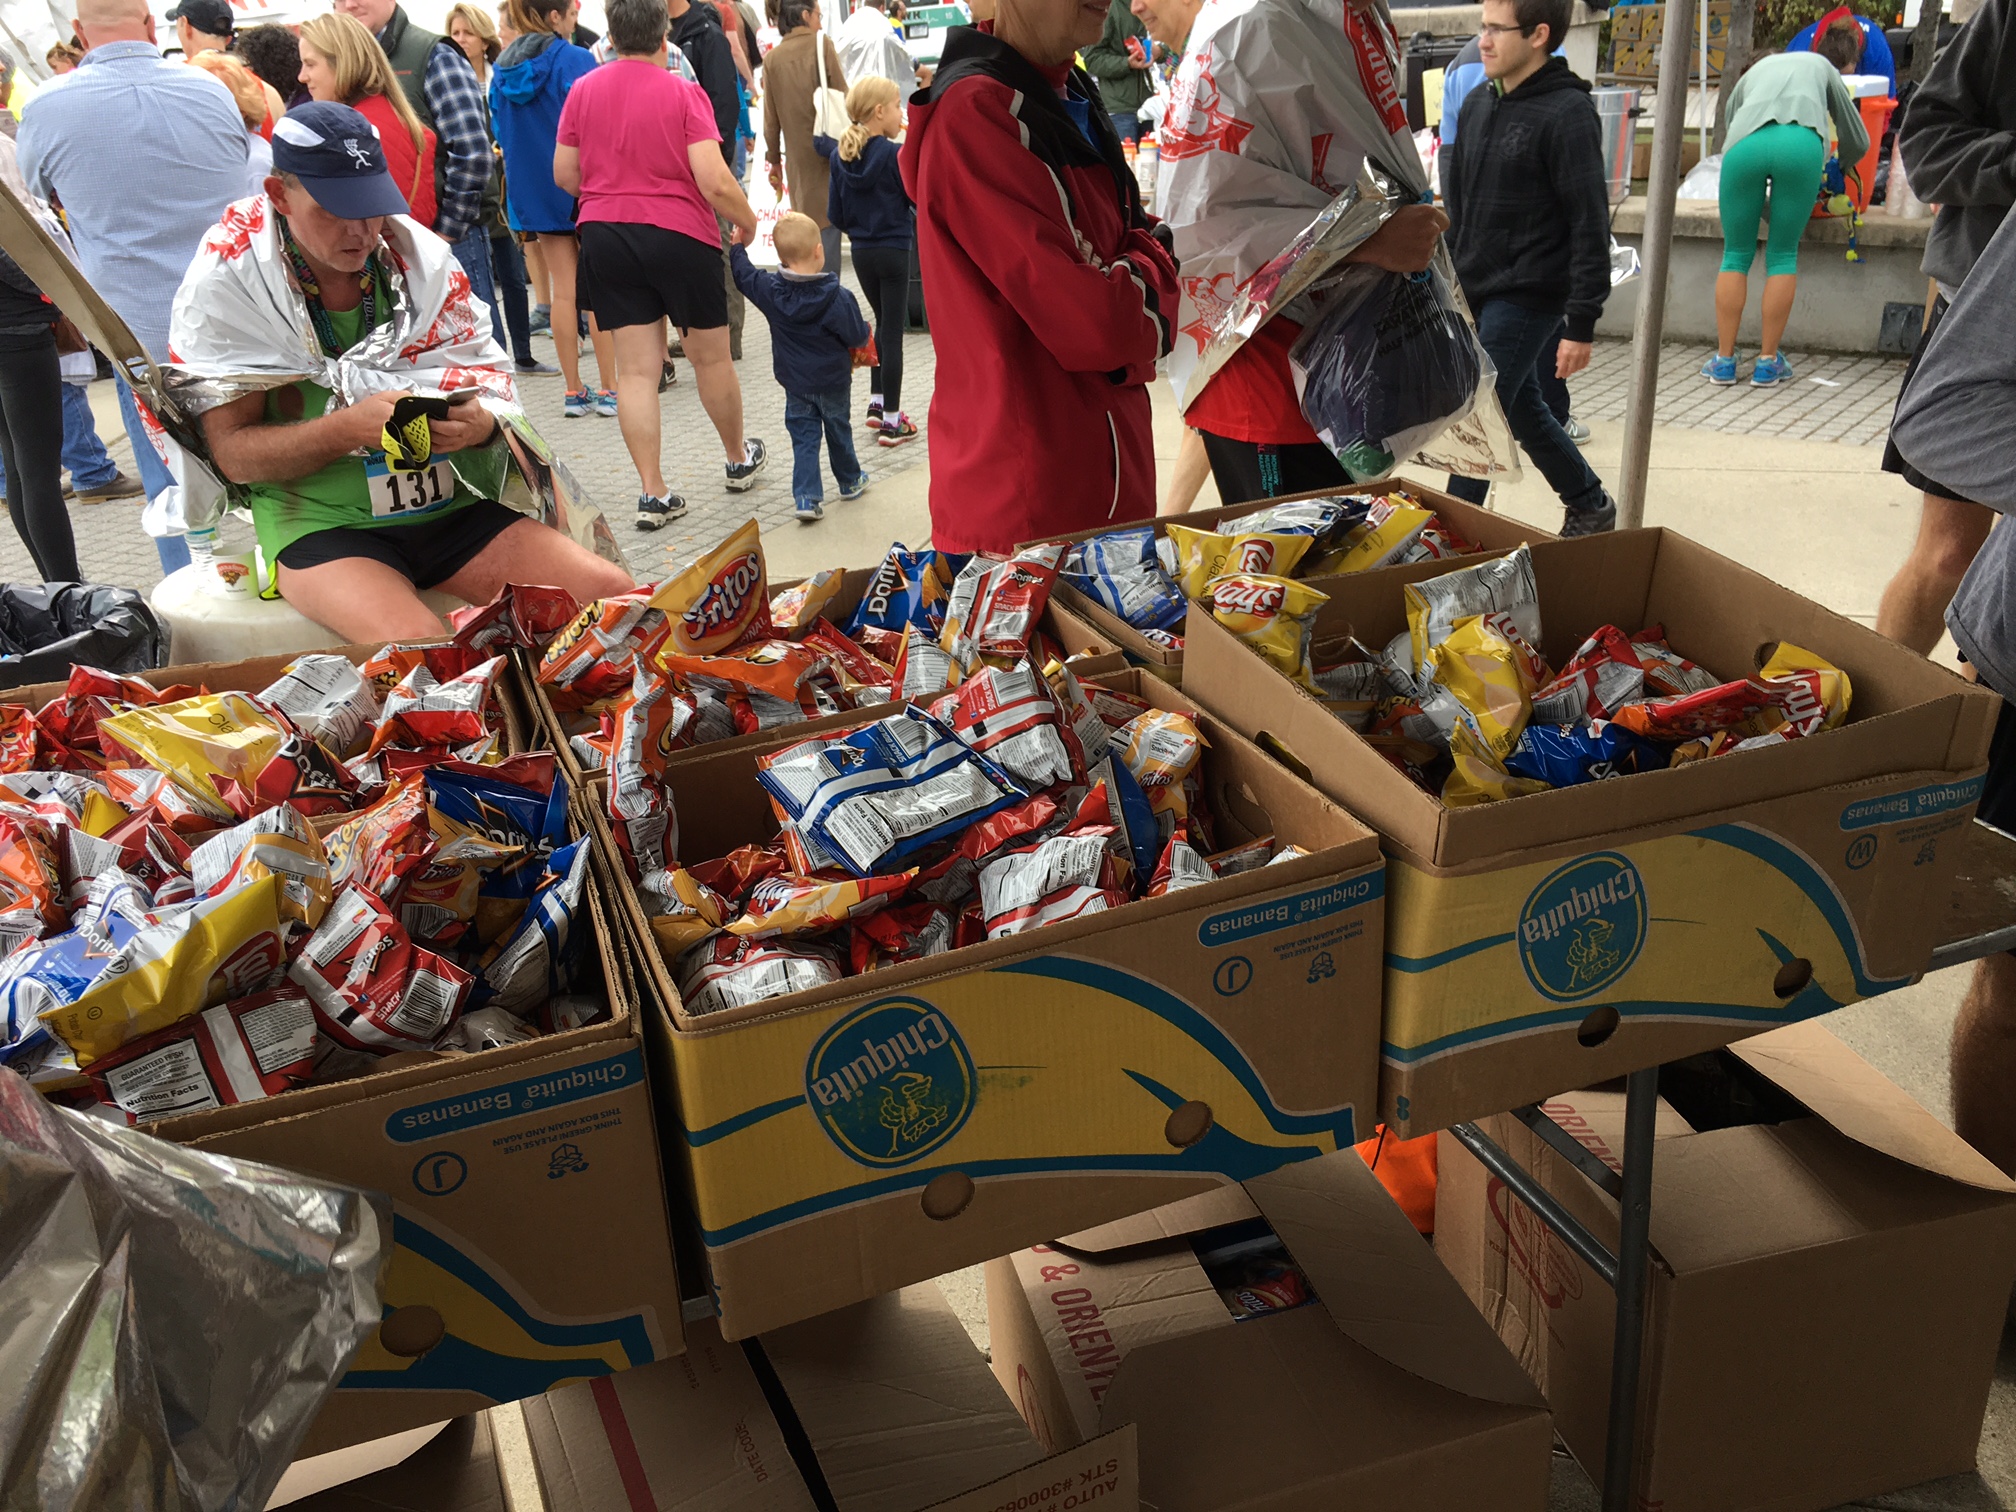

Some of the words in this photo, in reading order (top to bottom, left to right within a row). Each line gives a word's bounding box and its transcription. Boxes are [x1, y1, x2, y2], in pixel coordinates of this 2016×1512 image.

[386, 466, 442, 512] 131
[1008, 570, 1045, 585] Doritos
[682, 552, 760, 640] Fritos
[1140, 771, 1174, 787] Fritos
[853, 802, 869, 824] Facts
[1847, 798, 1909, 820] Bananas
[868, 812, 891, 846] Nutrition
[419, 864, 465, 881] Fritos
[1300, 881, 1370, 913] Chiquita
[1522, 868, 1636, 943] Chiquita
[1208, 905, 1289, 936] Bananas
[347, 935, 394, 984] Doritos
[1228, 962, 1241, 990] J
[376, 991, 402, 1020] SNACK
[121, 1057, 165, 1081] GUARANTEED
[810, 1013, 950, 1106] Chiquita
[526, 1063, 627, 1099] Chiquita
[126, 1092, 169, 1108] Nutrition
[170, 1084, 200, 1097] Facts
[402, 1092, 512, 1129] Bananas
[579, 1113, 599, 1125] BOX
[594, 1118, 622, 1131] THINK
[601, 1107, 621, 1119] THIS
[525, 1126, 546, 1138] AND
[548, 1117, 578, 1133] AGAIN
[492, 1132, 523, 1147] AGAIN
[503, 1145, 522, 1155] USE
[523, 1134, 557, 1150] PLEASE
[432, 1159, 448, 1188] J
[1041, 1264, 1081, 1283] &
[735, 1418, 756, 1451] CODE:
[747, 1450, 769, 1484] DATE
[1079, 1458, 1119, 1486] STK
[1063, 1477, 1119, 1510] AUTO
